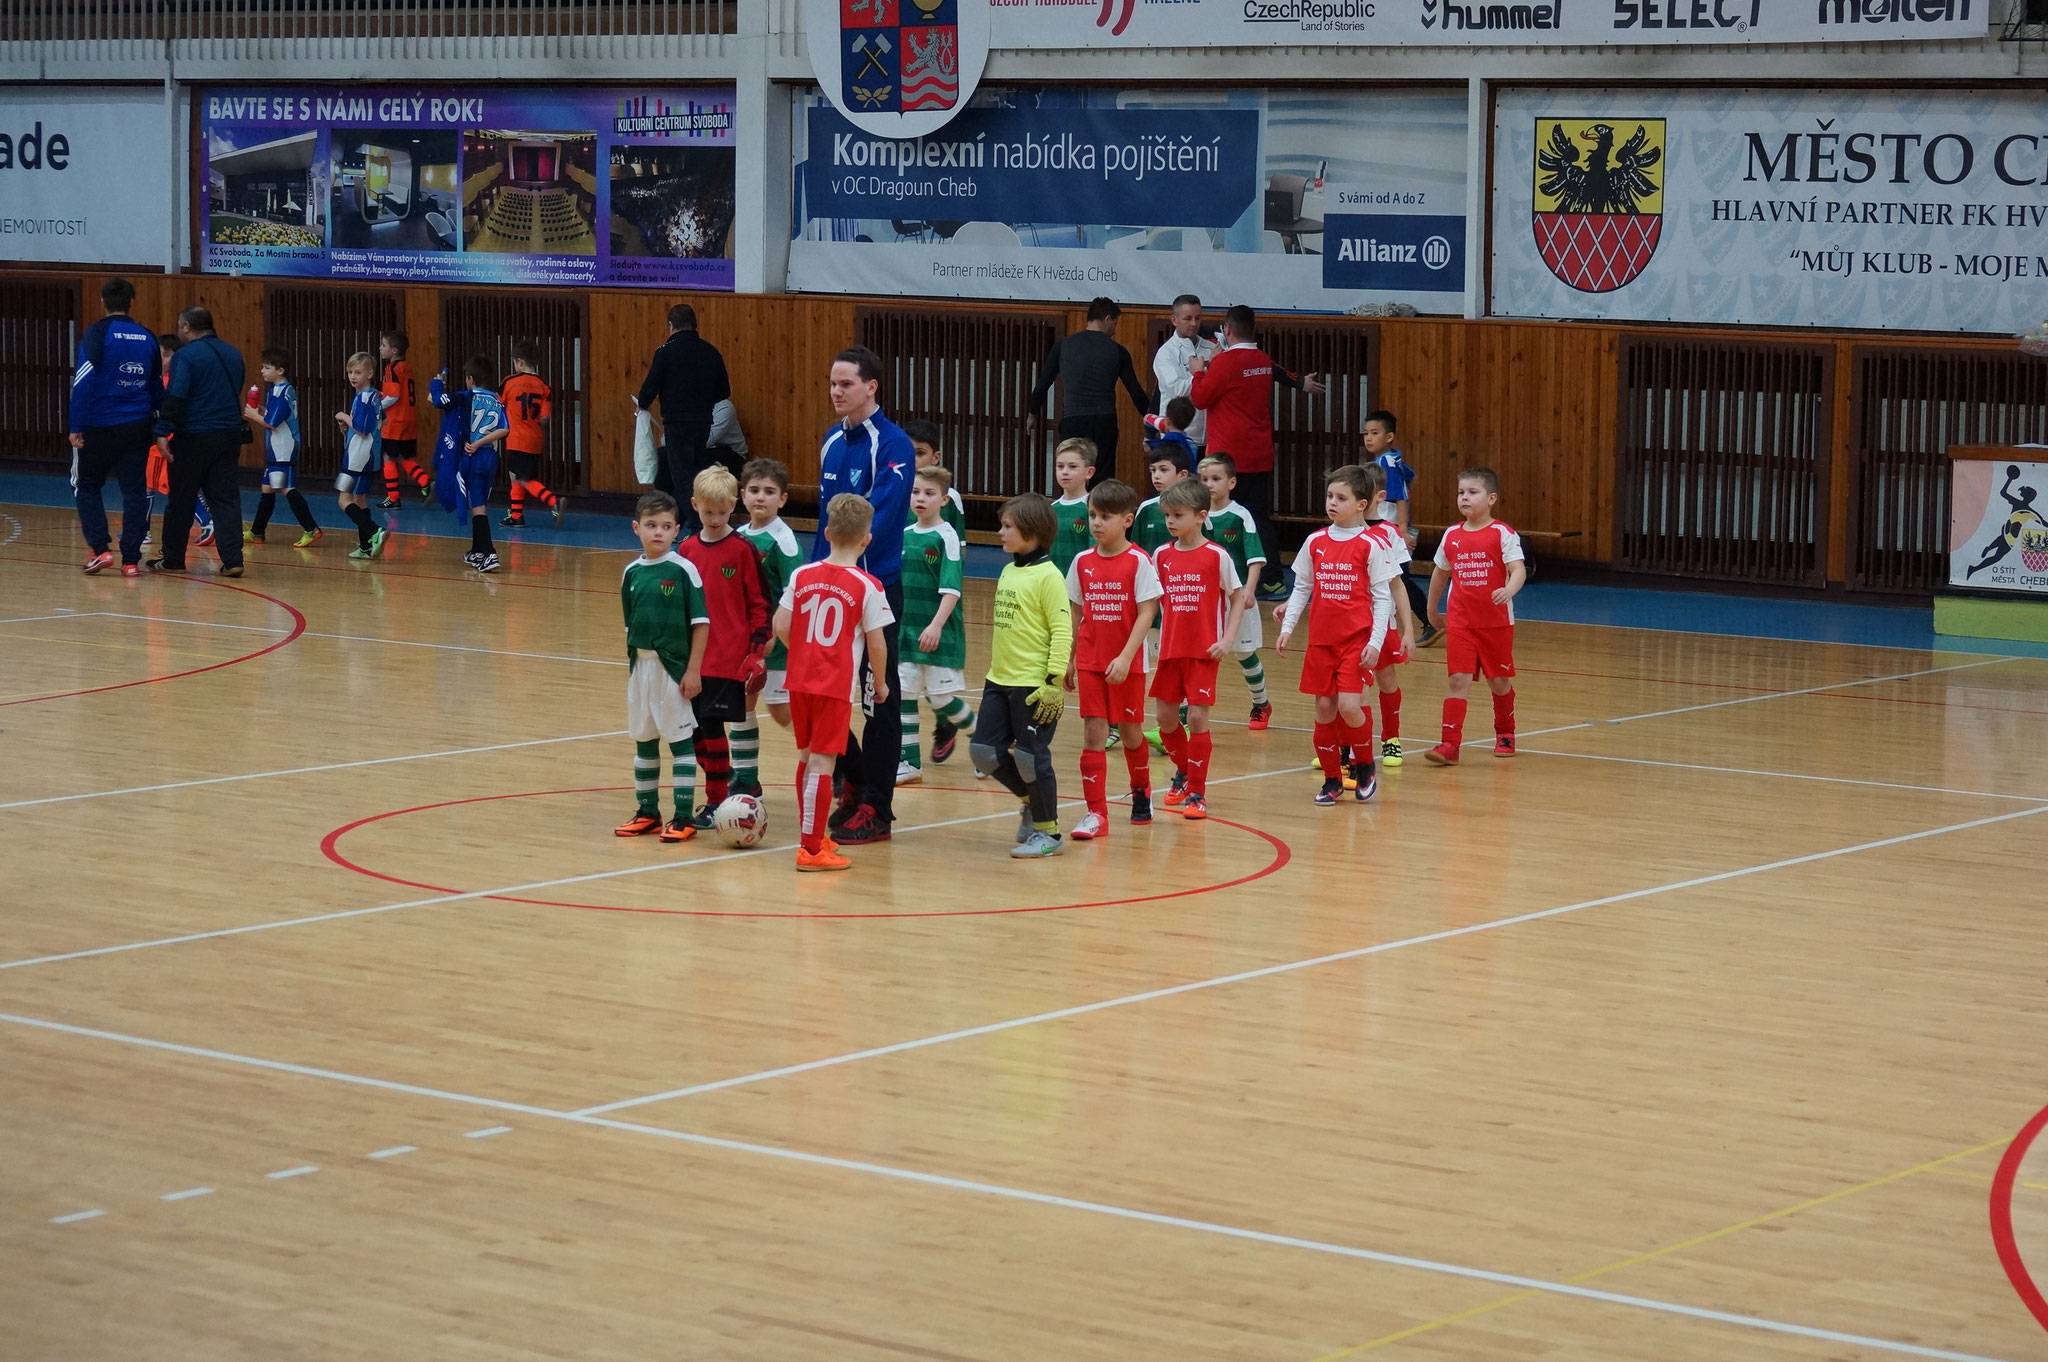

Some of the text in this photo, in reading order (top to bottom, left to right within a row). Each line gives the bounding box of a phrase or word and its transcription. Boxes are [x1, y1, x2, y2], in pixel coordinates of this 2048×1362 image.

[1442, 0, 1562, 30] hummel
[1301, 21, 1365, 31] Land of Stories
[209, 90, 484, 122] BAVTE SE S NÁMI CELÝ ROK!
[618, 114, 728, 132] KULTURNÍ CENTRUM SVOBODA
[834, 132, 1222, 181] Komplexní nabídka pojištění
[1743, 118, 2048, 186] MĚSTO C
[832, 176, 977, 200] v OC Dragoun Cheb
[1338, 192, 1425, 204] S vámi od A do Z
[1711, 196, 1818, 222] HLAVNÍ
[1825, 202, 1954, 226] PARTNER
[1962, 204, 1998, 226] FK
[0, 216, 87, 236] EMOVITOSTÍ
[209, 248, 218, 256] KC
[220, 248, 253, 258] Svoboda,
[254, 249, 264, 257] Za
[292, 250, 320, 259] branou
[1338, 238, 1416, 262] Allianz
[208, 259, 252, 268] 350 02 Cheb
[386, 253, 418, 264] prostory
[419, 254, 424, 263] k
[506, 257, 535, 268] svatby,
[536, 257, 566, 268] rodinné
[568, 258, 596, 270] oslavy,
[610, 260, 642, 271] Sledujte
[1862, 252, 1932, 274] KLUB
[1954, 254, 2028, 282] MOJE
[932, 262, 1118, 282] Partner mládeže FK Hvězda Cheb
[515, 392, 542, 421] 15
[470, 408, 498, 435] 12
[1454, 560, 1494, 570] Schreinerei
[1169, 574, 1181, 582] Seit
[1316, 571, 1358, 582] Schreinerei
[1458, 569, 1488, 579] Feustel
[2020, 576, 2048, 586] CHEB
[795, 582, 856, 607] DREIBERG KICKERS
[1166, 583, 1206, 593] Schreinerei
[1320, 581, 1352, 592] Feustel
[1085, 592, 1128, 601] Schreinerei
[1170, 594, 1200, 603] Feustel
[1091, 602, 1122, 612] Feustel
[800, 594, 844, 647] 10
[864, 662, 876, 718] LEGE
